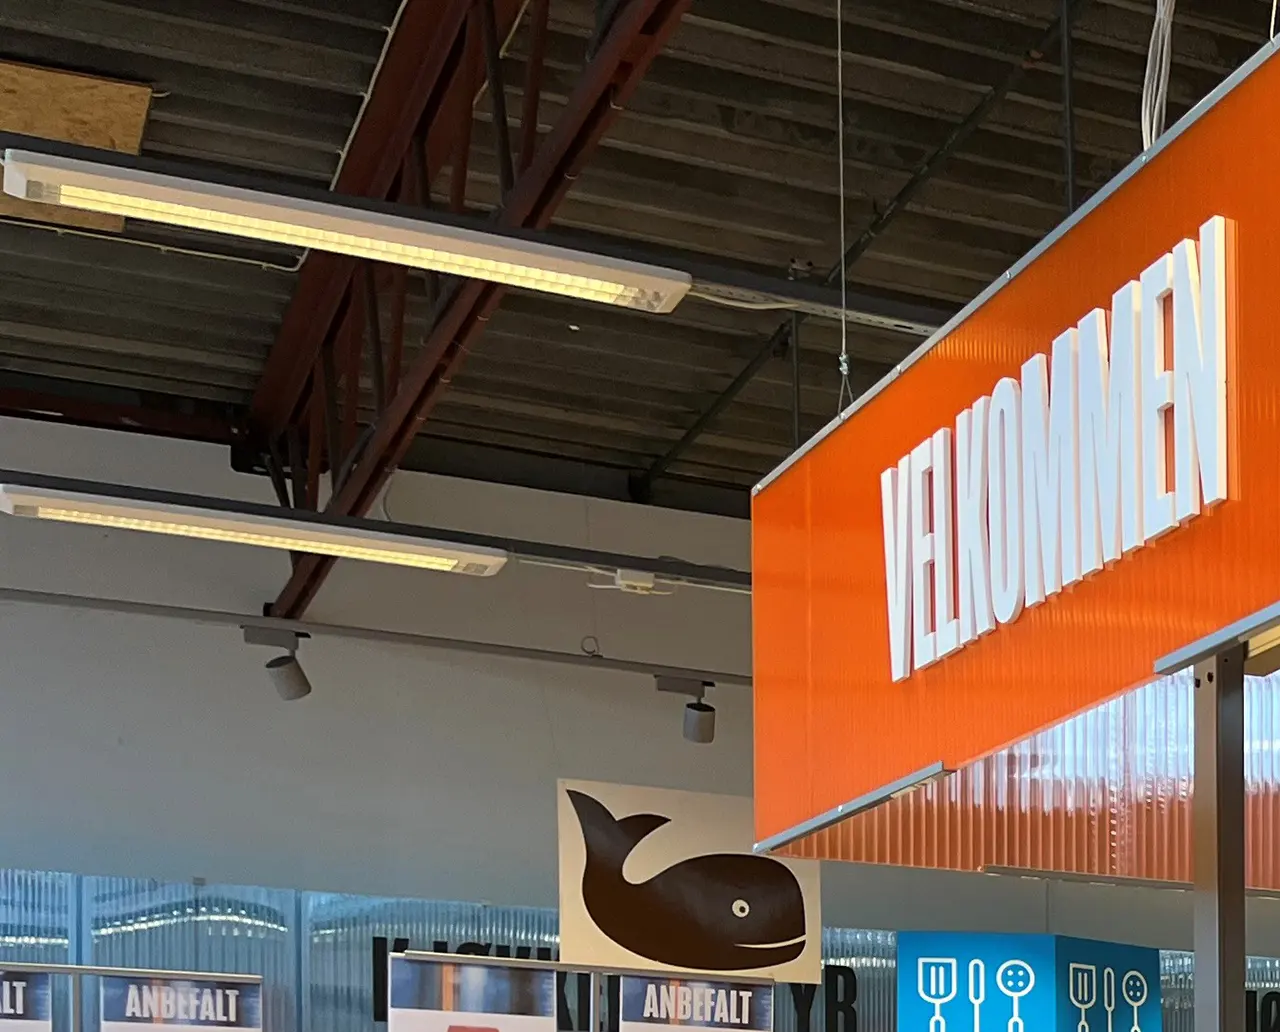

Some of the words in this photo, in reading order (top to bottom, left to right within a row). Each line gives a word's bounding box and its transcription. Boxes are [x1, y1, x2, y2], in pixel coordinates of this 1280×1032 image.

[881, 215, 1227, 683] VELKOMMEN
[126, 984, 239, 1022] ANBEFALT
[643, 984, 752, 1024] ANBEFALT
